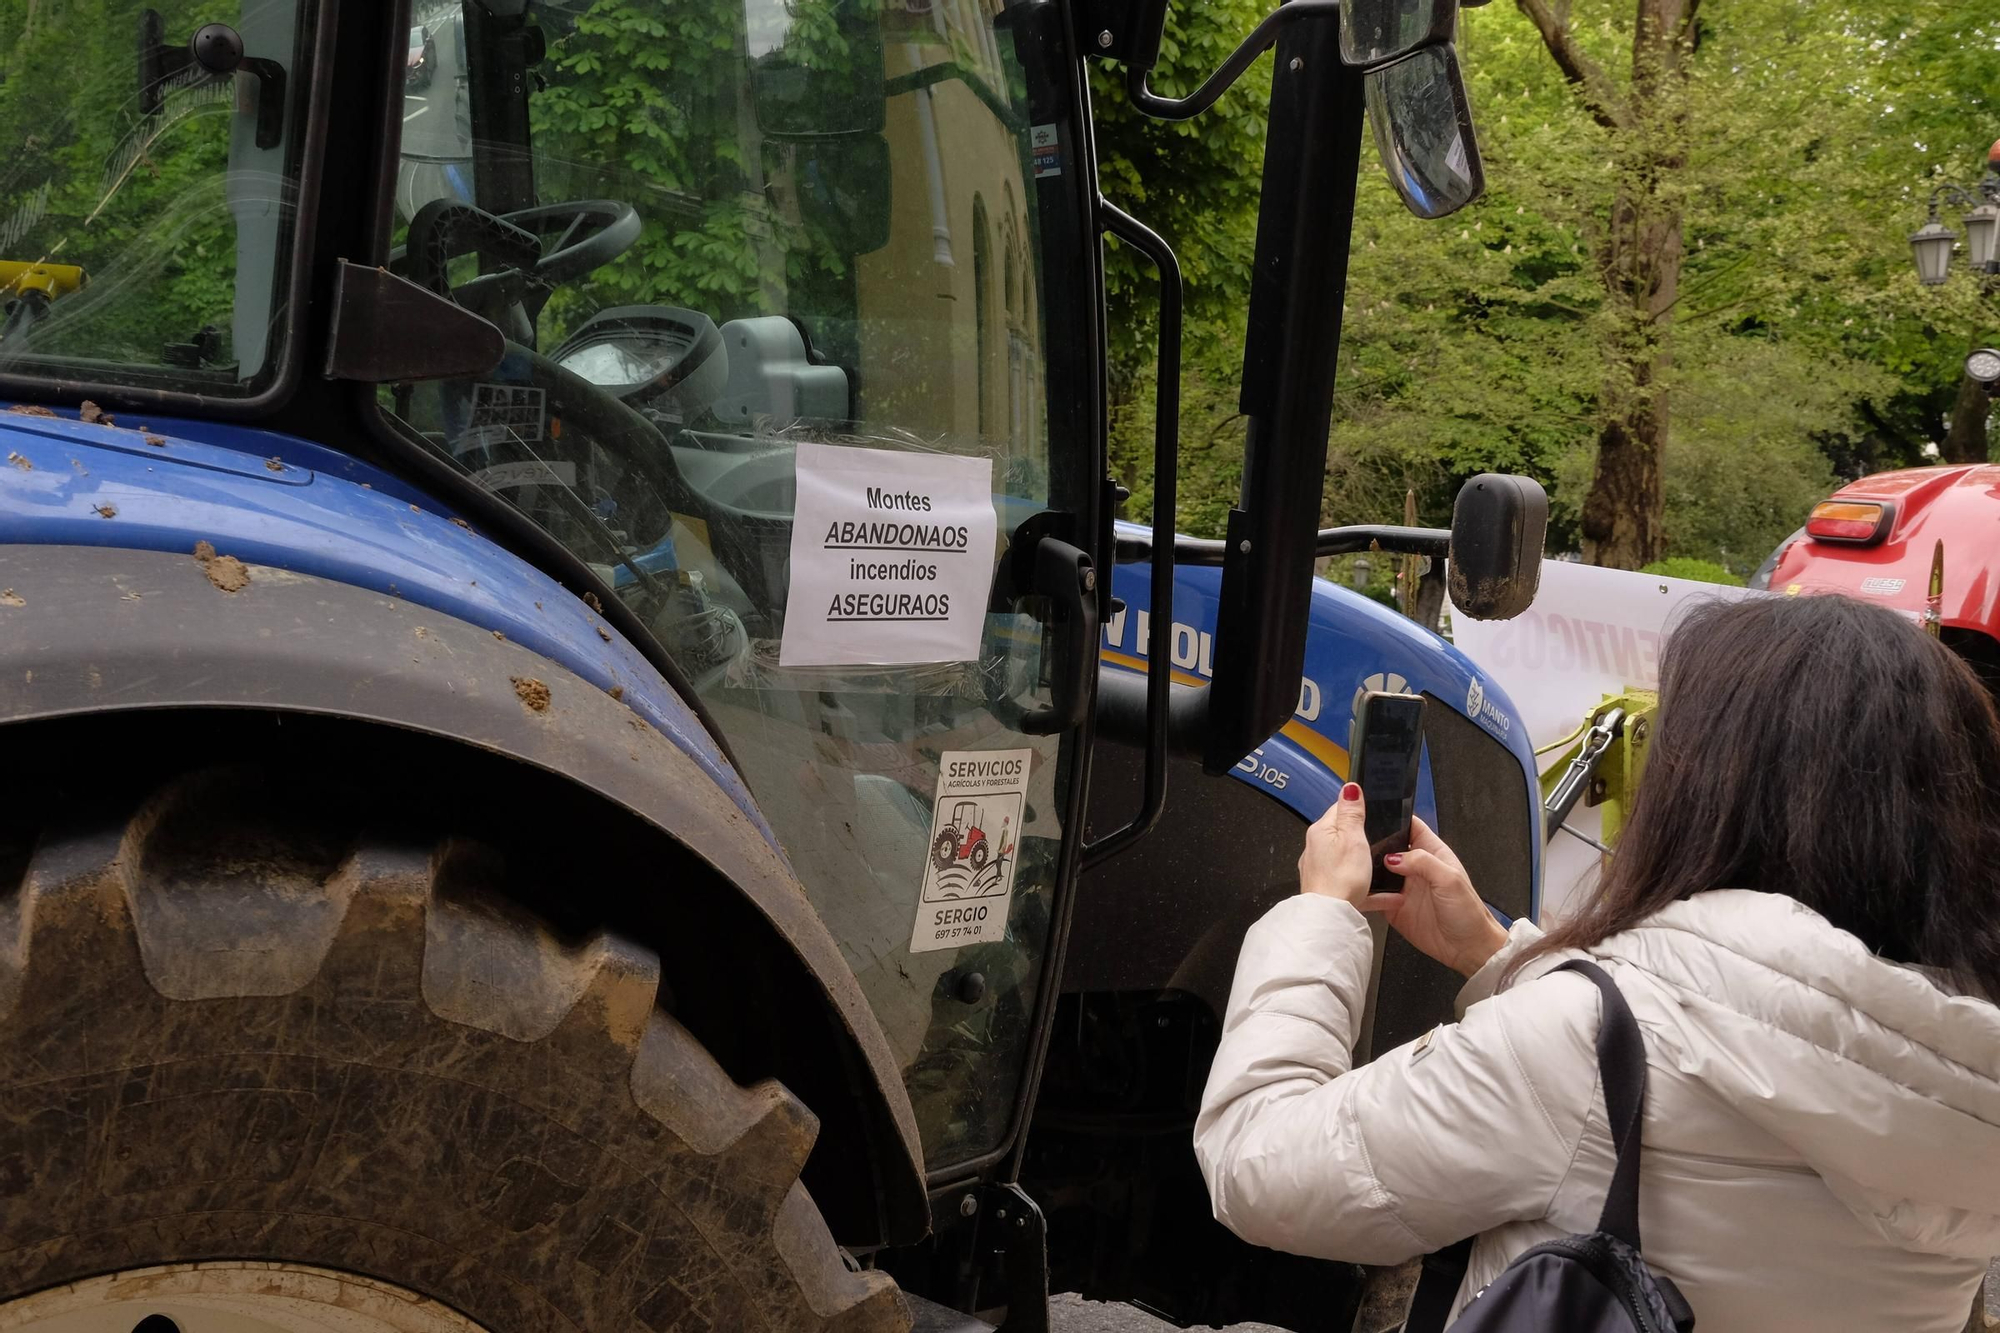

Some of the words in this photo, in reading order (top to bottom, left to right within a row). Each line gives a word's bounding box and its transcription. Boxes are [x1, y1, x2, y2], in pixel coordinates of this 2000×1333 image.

[867, 487, 931, 511] Montes
[825, 522, 968, 548] ABANDONAOS
[850, 558, 937, 580] incendios
[828, 594, 949, 616] ASEGURAOS
[1481, 699, 1510, 731] MANTO
[949, 760, 1022, 777] SERVICIOS
[948, 779, 981, 788] AGRÍCOLAS
[981, 779, 986, 787] Y
[986, 778, 1020, 787] FORESTALES
[934, 906, 987, 925] SERGIO
[935, 929, 950, 939] 697
[951, 928, 962, 937] 57
[963, 927, 973, 936] 74
[973, 926, 982, 935] 01
